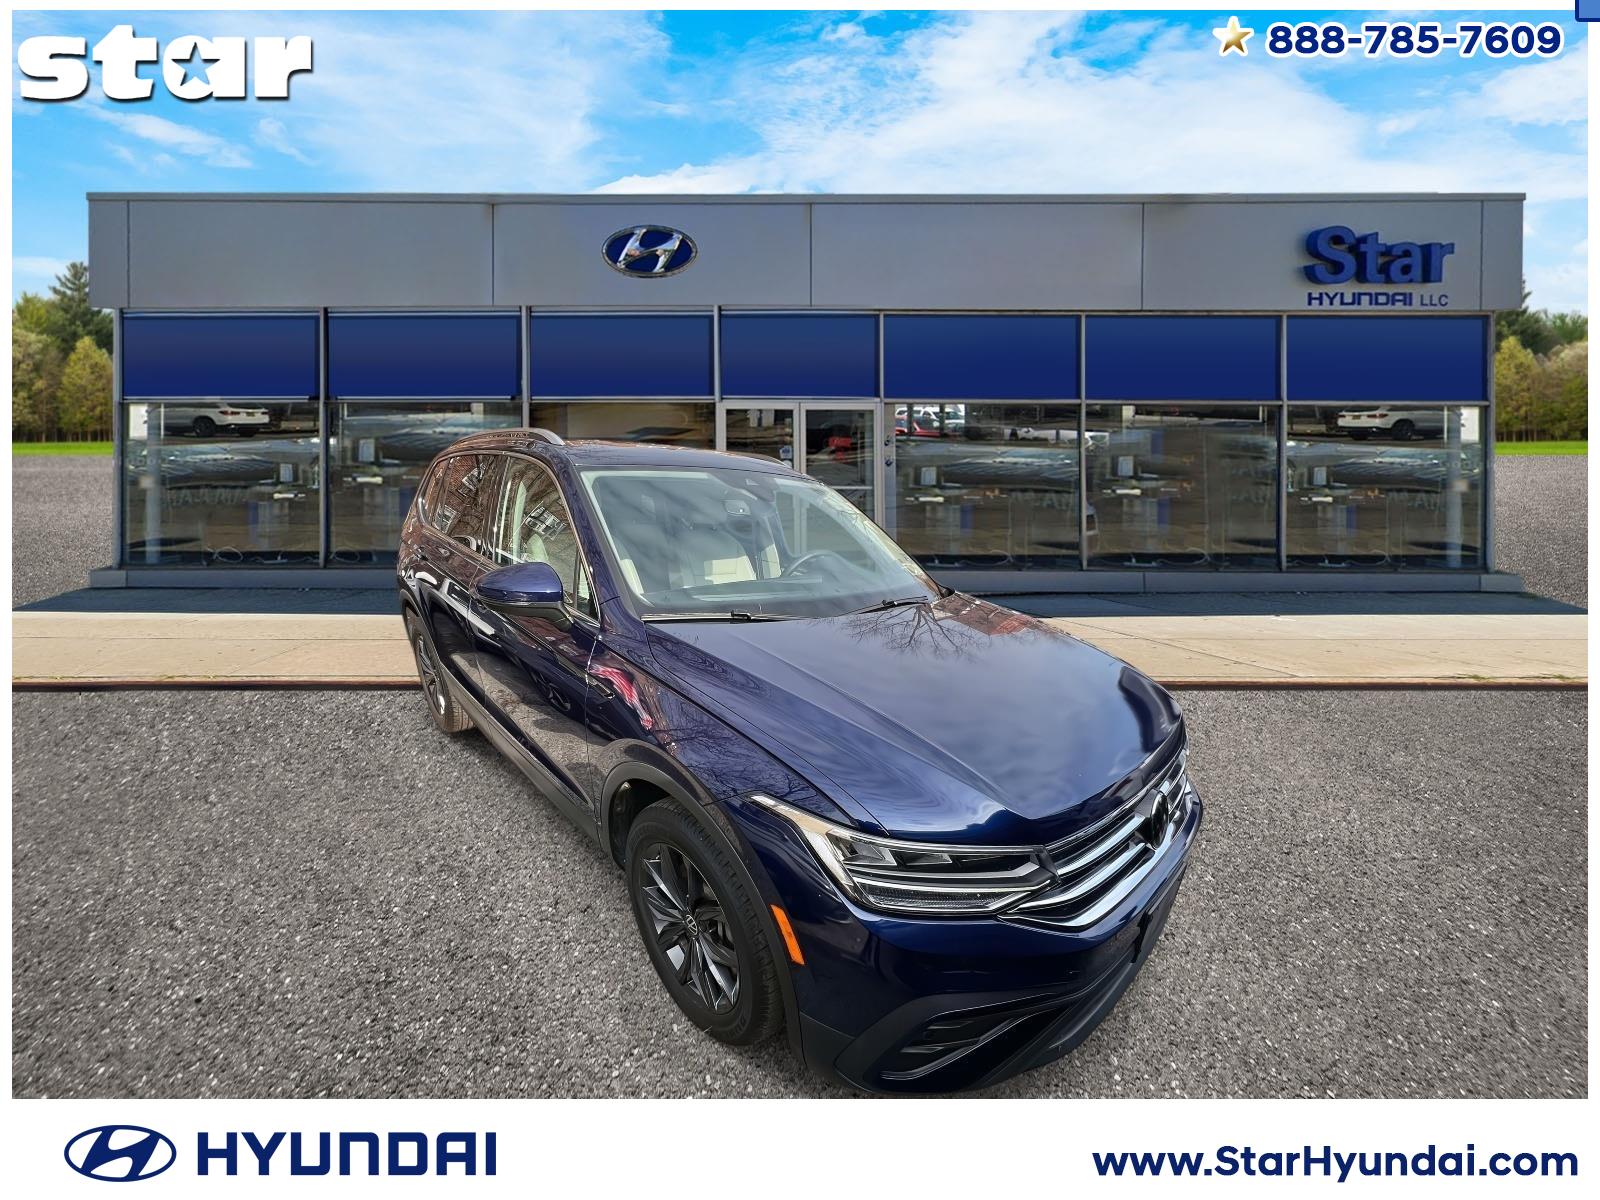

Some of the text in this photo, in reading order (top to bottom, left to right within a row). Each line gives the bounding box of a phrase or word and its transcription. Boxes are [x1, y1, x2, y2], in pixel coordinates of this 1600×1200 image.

[1304, 225, 1455, 284] Star
[1307, 292, 1448, 307] HYUNDAI LLC
